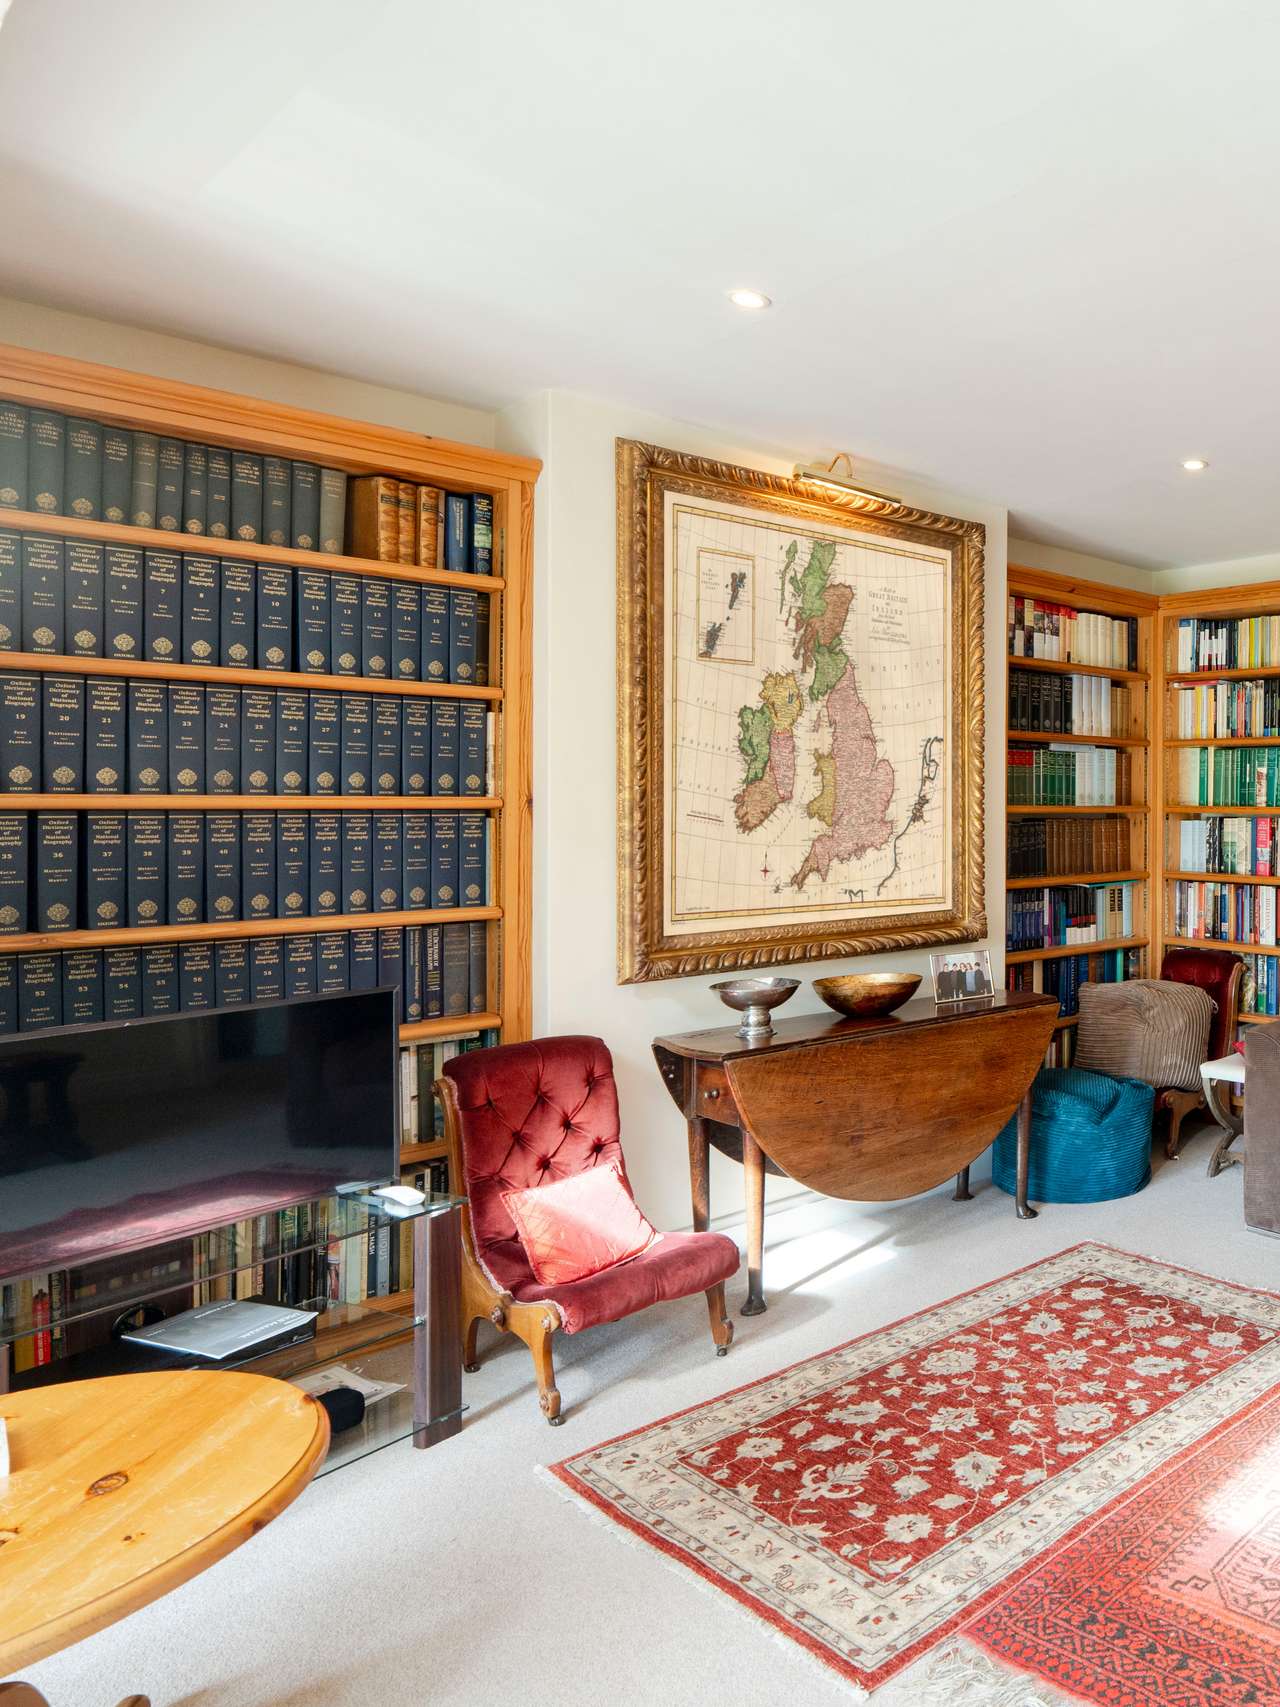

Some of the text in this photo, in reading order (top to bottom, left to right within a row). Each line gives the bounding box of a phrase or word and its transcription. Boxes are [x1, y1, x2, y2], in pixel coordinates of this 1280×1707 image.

[28, 546, 58, 555] Dictionary
[30, 556, 56, 564] National
[28, 561, 58, 570] Biography
[188, 565, 214, 573] Dictionary
[188, 579, 214, 587] Biography
[263, 588, 286, 596] Biography
